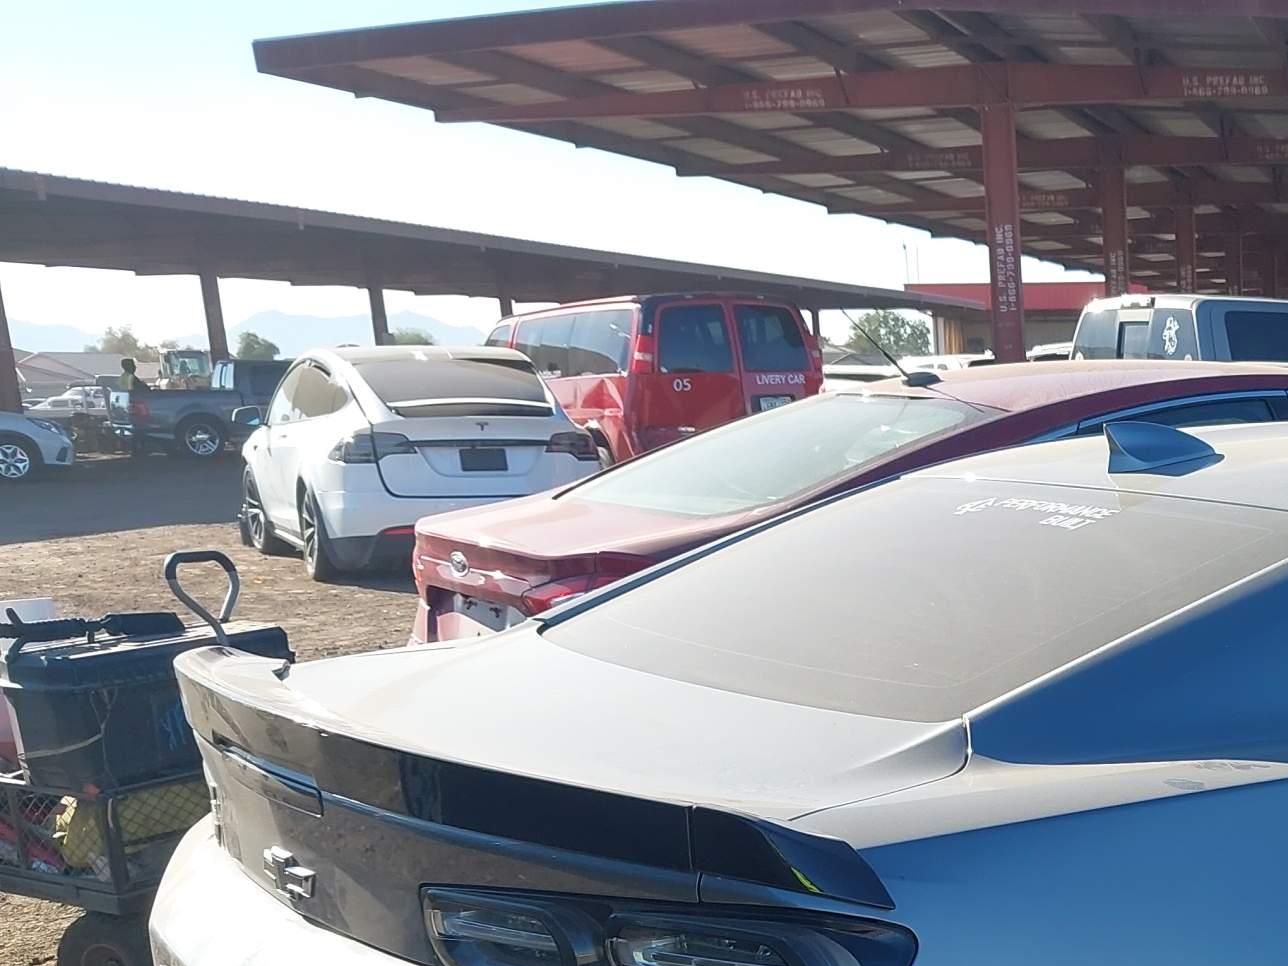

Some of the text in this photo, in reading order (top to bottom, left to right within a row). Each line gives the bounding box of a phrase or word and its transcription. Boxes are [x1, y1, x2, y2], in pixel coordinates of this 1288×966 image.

[673, 378, 692, 392] 05
[756, 374, 806, 385] LIVERY CAR
[1039, 514, 1097, 531] BUILT
